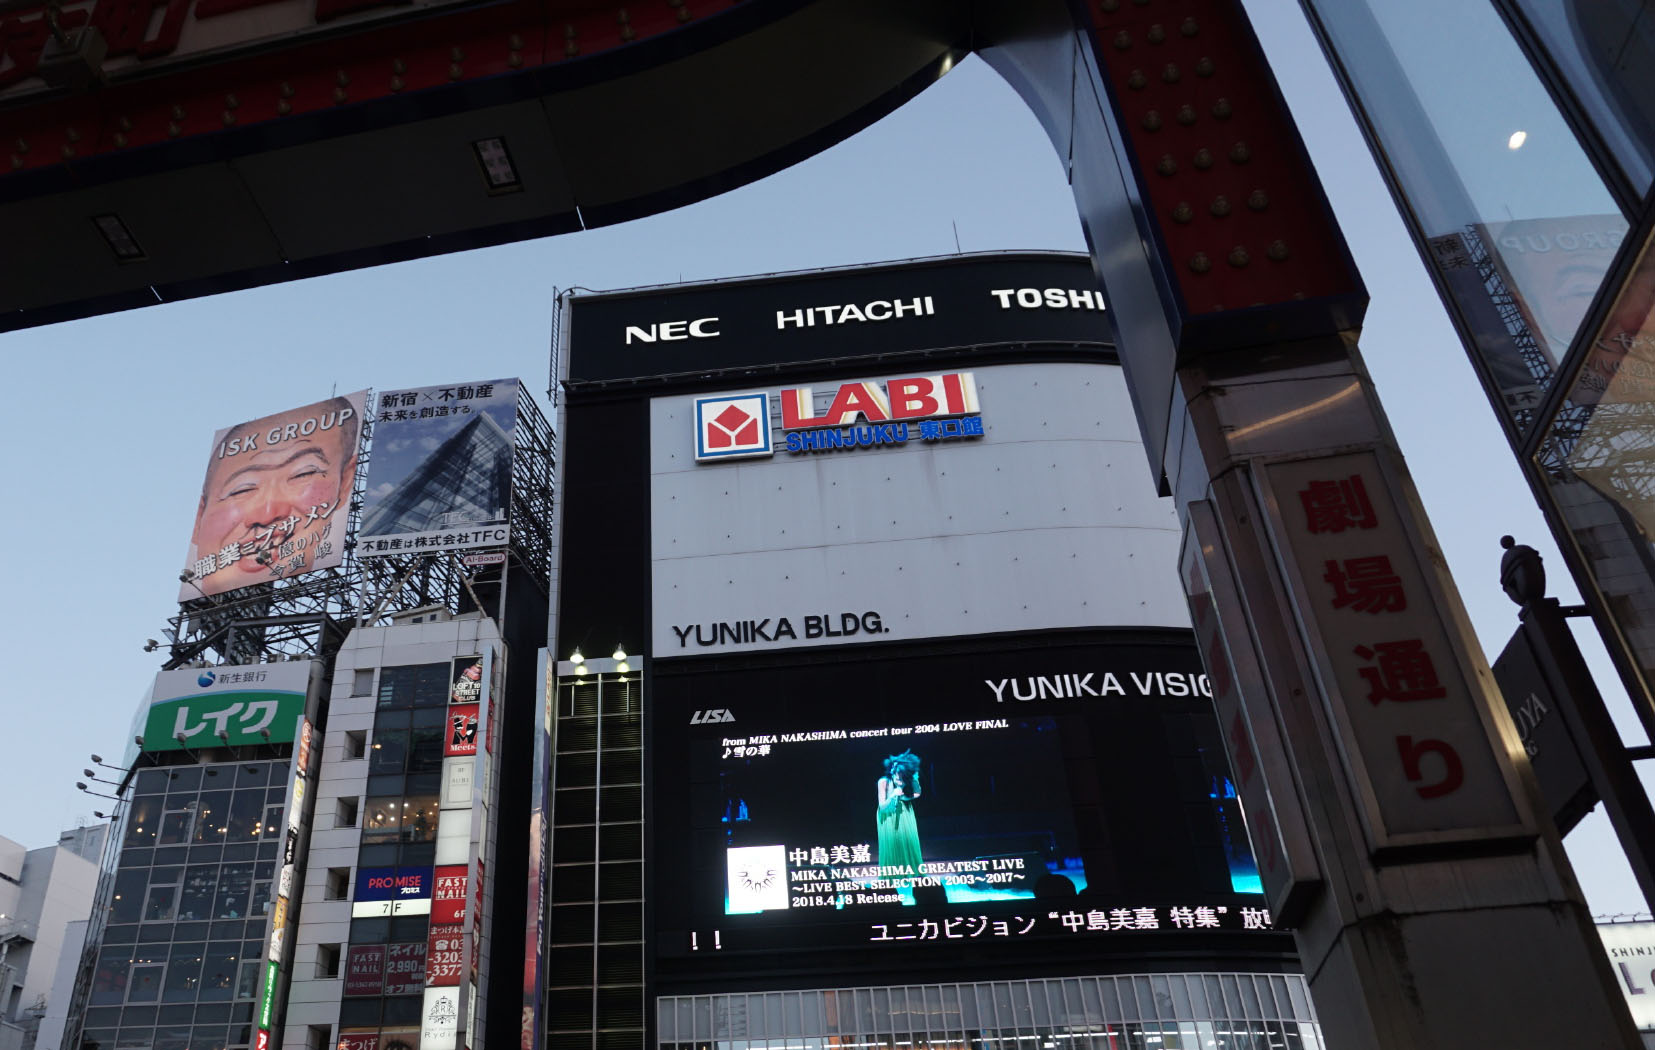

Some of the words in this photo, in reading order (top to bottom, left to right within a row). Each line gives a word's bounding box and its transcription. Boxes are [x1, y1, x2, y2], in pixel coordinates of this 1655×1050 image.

[990, 288, 1106, 311] TOSHI
[775, 296, 935, 330] HITACHI
[625, 317, 721, 345] NEC
[780, 372, 981, 430] LABI
[218, 433, 260, 459] ISK
[266, 407, 354, 446] GROUP
[785, 422, 909, 452] SHINJUKU
[918, 416, 984, 440] 東口館
[362, 528, 507, 553] 不動産は株式会社TFC
[671, 617, 797, 648] YUNIKA
[803, 611, 890, 640] BLDG.
[1297, 473, 1465, 801] 劇場通り
[218, 670, 268, 685] 新生銀行
[984, 672, 1126, 703] YUNIKA
[455, 688, 480, 697] STREET
[172, 700, 279, 739] レイク
[690, 708, 736, 725] LISA
[722, 738, 747, 747] from
[749, 734, 778, 745] MIKA
[780, 730, 847, 743] NAKASHIMA
[850, 728, 888, 739] concert
[891, 727, 912, 736] tour
[915, 724, 940, 734] 2004
[943, 721, 973, 732] LOVE
[975, 719, 1009, 730] FINAL
[789, 844, 871, 867] 中島美嘉
[791, 869, 828, 882] MIKA
[831, 864, 915, 880] NAKASHIMA
[918, 859, 989, 875] GREATEST
[992, 858, 1025, 870] LIVE
[437, 889, 467, 899] NAIL
[438, 878, 467, 888] FAST
[835, 879, 866, 892] BEST
[870, 876, 942, 890] SELECTION
[792, 894, 854, 908] 2018.4.18
[856, 893, 905, 905] Release
[869, 914, 1036, 941] ユニカビジョン
[352, 954, 382, 963] FAST
[390, 943, 427, 957] ネイル
[1611, 946, 1655, 958] SHINJ
[351, 964, 380, 974] NAIL
